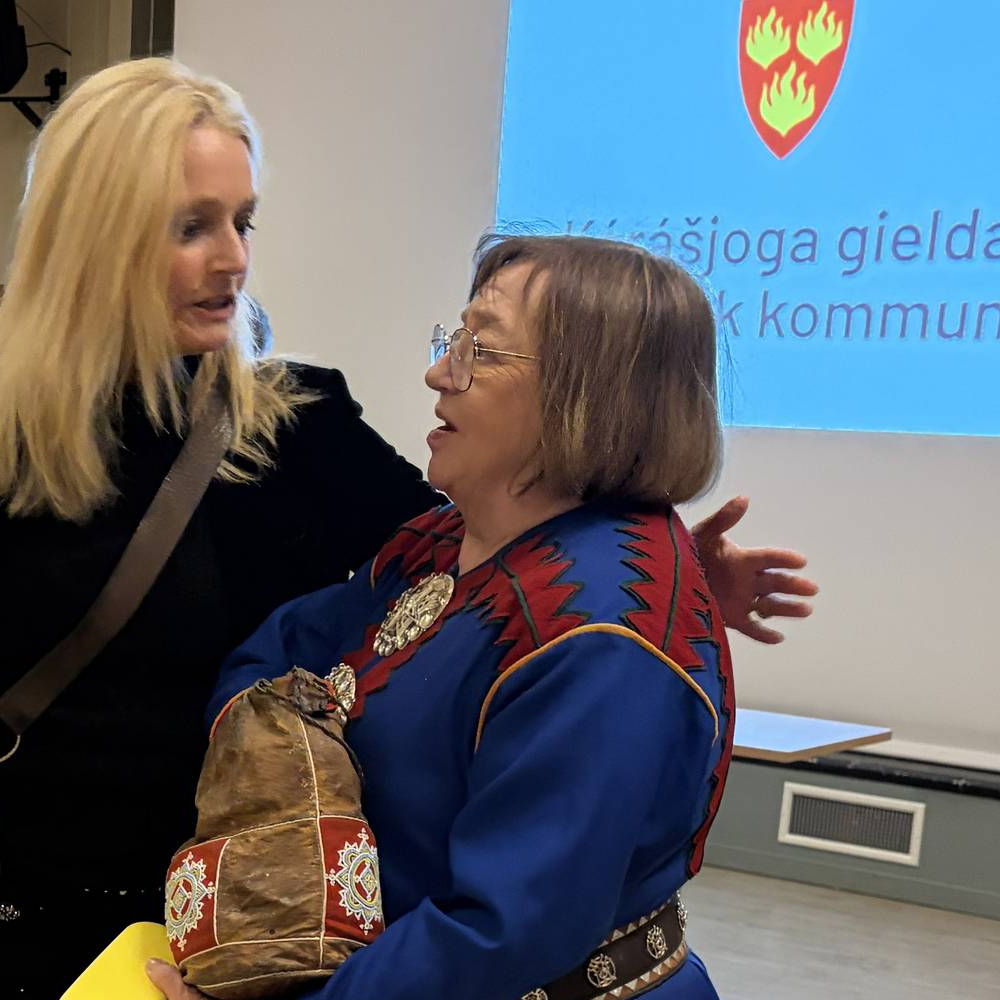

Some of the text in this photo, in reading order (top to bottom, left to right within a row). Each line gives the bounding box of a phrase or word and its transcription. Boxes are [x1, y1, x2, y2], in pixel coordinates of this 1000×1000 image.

[566, 208, 1000, 277] ášjoga gielda
[759, 289, 1000, 340] kommun
